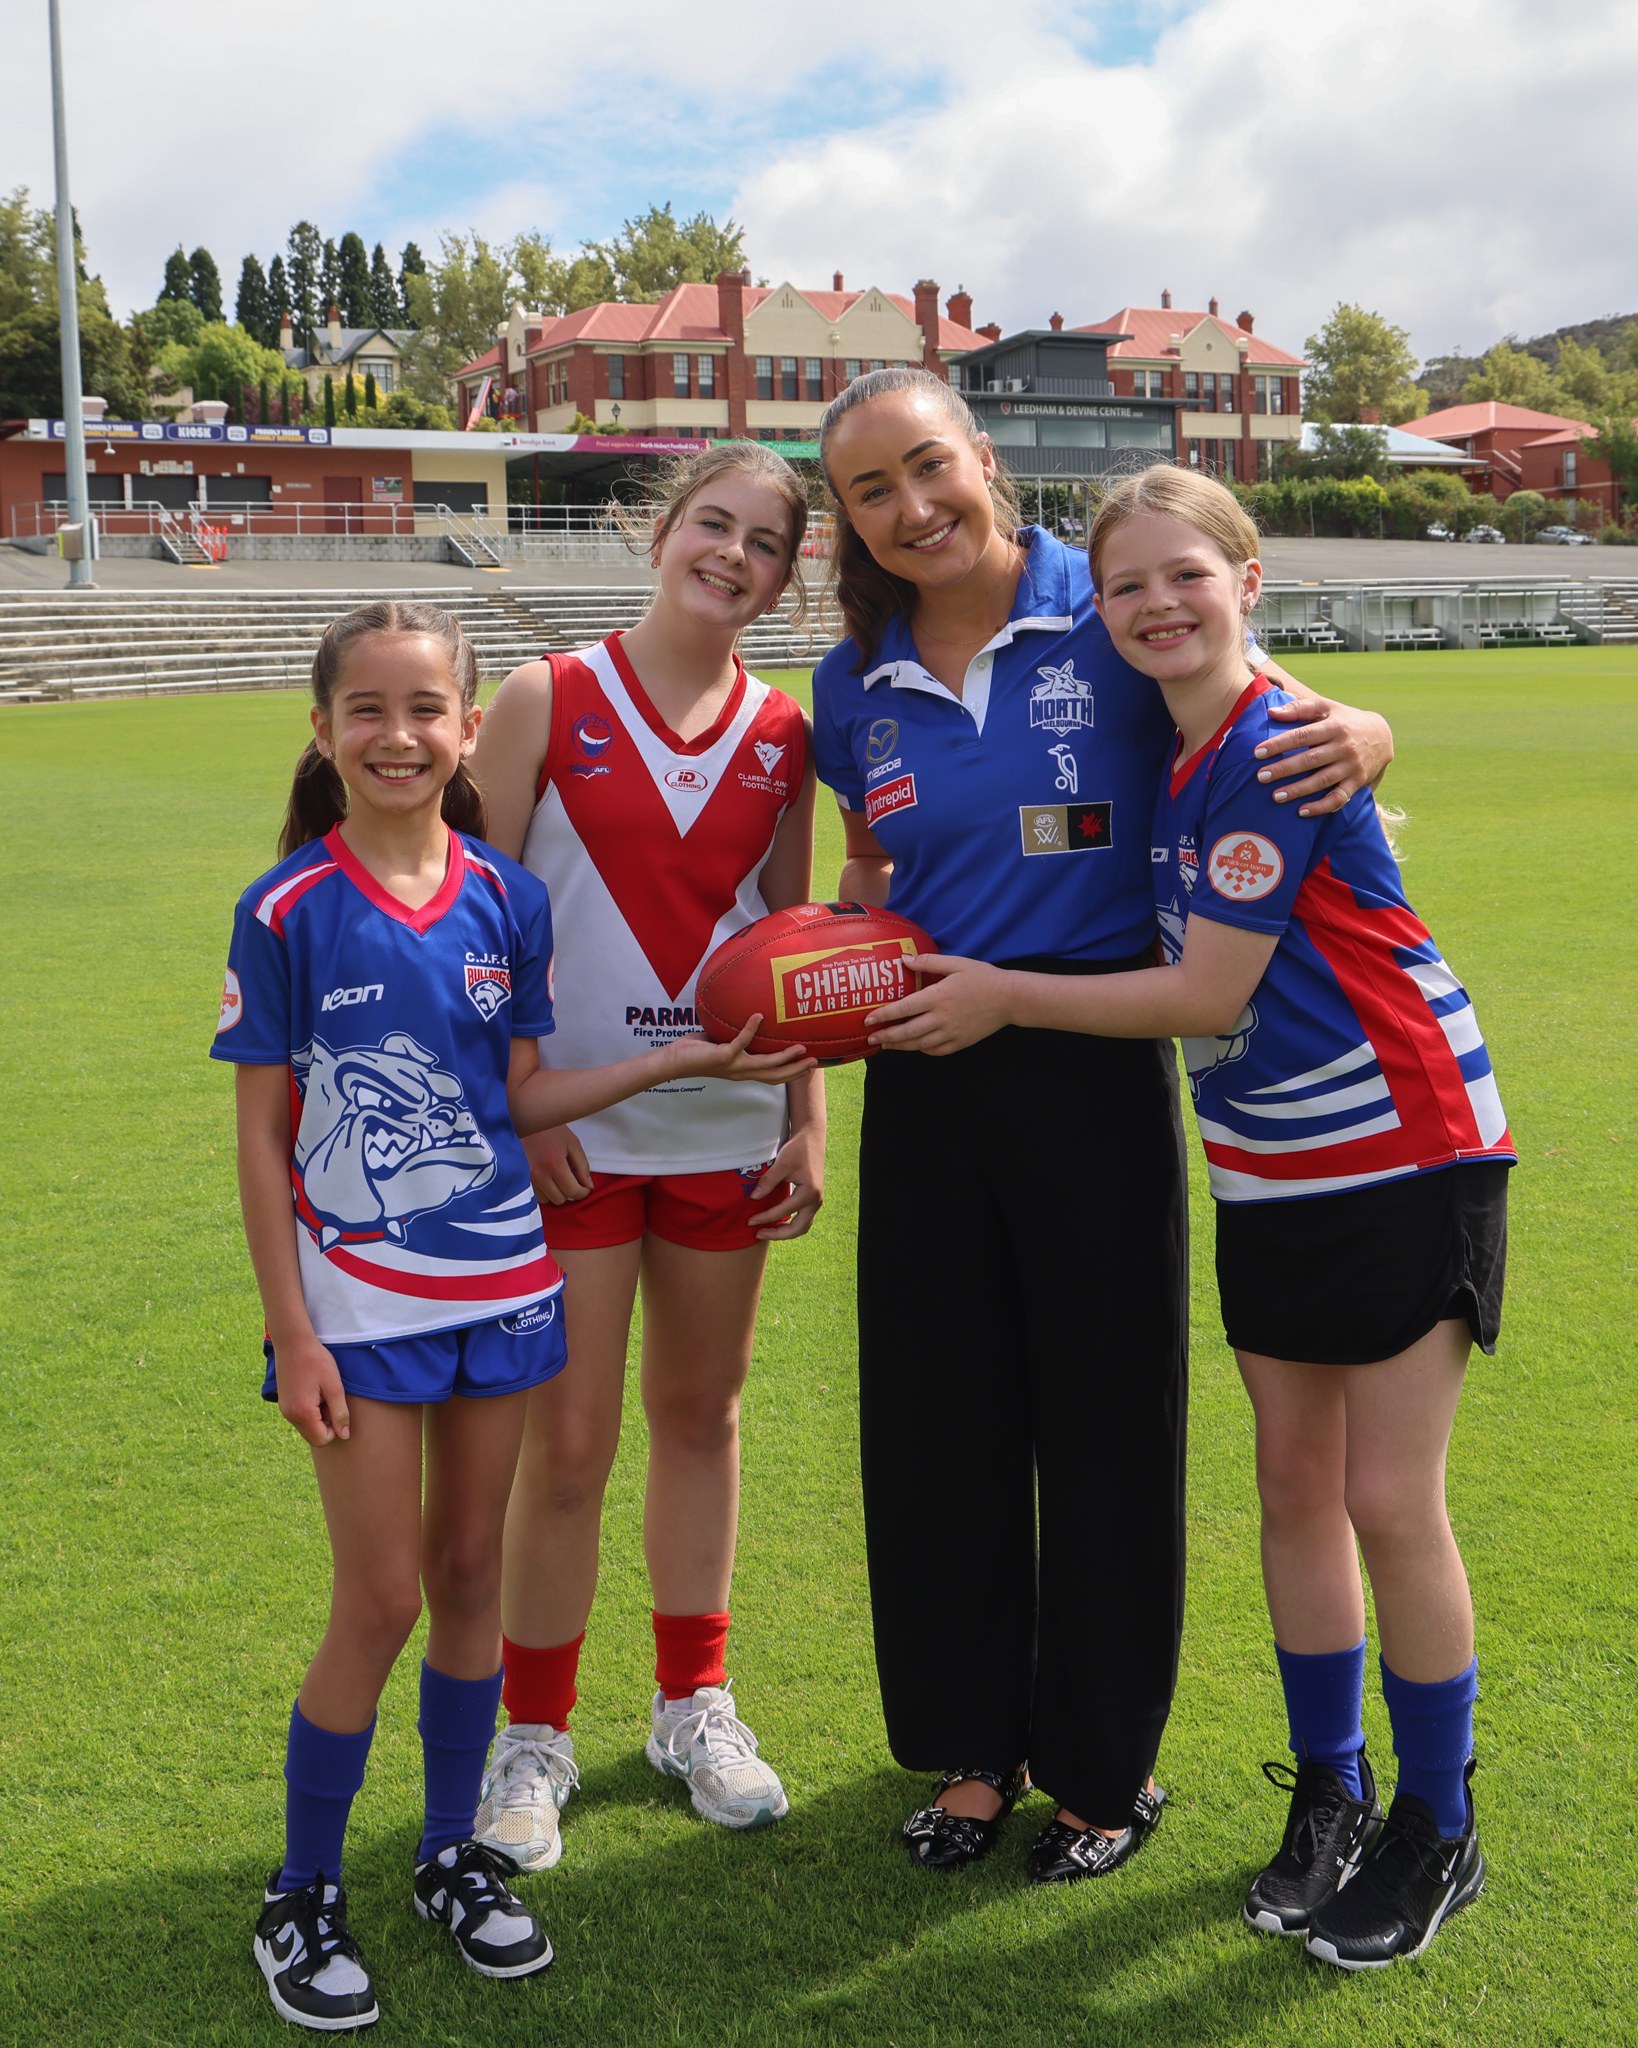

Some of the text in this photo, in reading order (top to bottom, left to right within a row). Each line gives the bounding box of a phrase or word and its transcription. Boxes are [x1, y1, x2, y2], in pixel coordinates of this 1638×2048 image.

[1014, 404, 1057, 415] LEEDHAM
[1058, 405, 1065, 415] &
[1066, 406, 1098, 416] DEVINE
[1099, 407, 1131, 417] CENTRE
[178, 426, 212, 438] KIOSK
[520, 438, 541, 446] Bendigo
[611, 441, 634, 449] supporters
[765, 442, 819, 453] Commercial
[1032, 697, 1092, 725] NORTH
[867, 757, 901, 783] mazda
[738, 773, 772, 784] CLARENCE
[671, 782, 702, 790] CLOTHING
[742, 781, 773, 793] FOOTBALL
[872, 782, 911, 813] Intrepid
[1222, 858, 1266, 872] chicken barn
[834, 959, 850, 968] Paying
[860, 955, 876, 963] Much!!
[467, 967, 511, 993] BULLDOGS
[794, 957, 904, 1000] CHEMIST
[797, 985, 904, 1015] WAREHOUSE
[633, 1028, 654, 1037] Fire
[511, 1311, 551, 1331] CLOTHING
